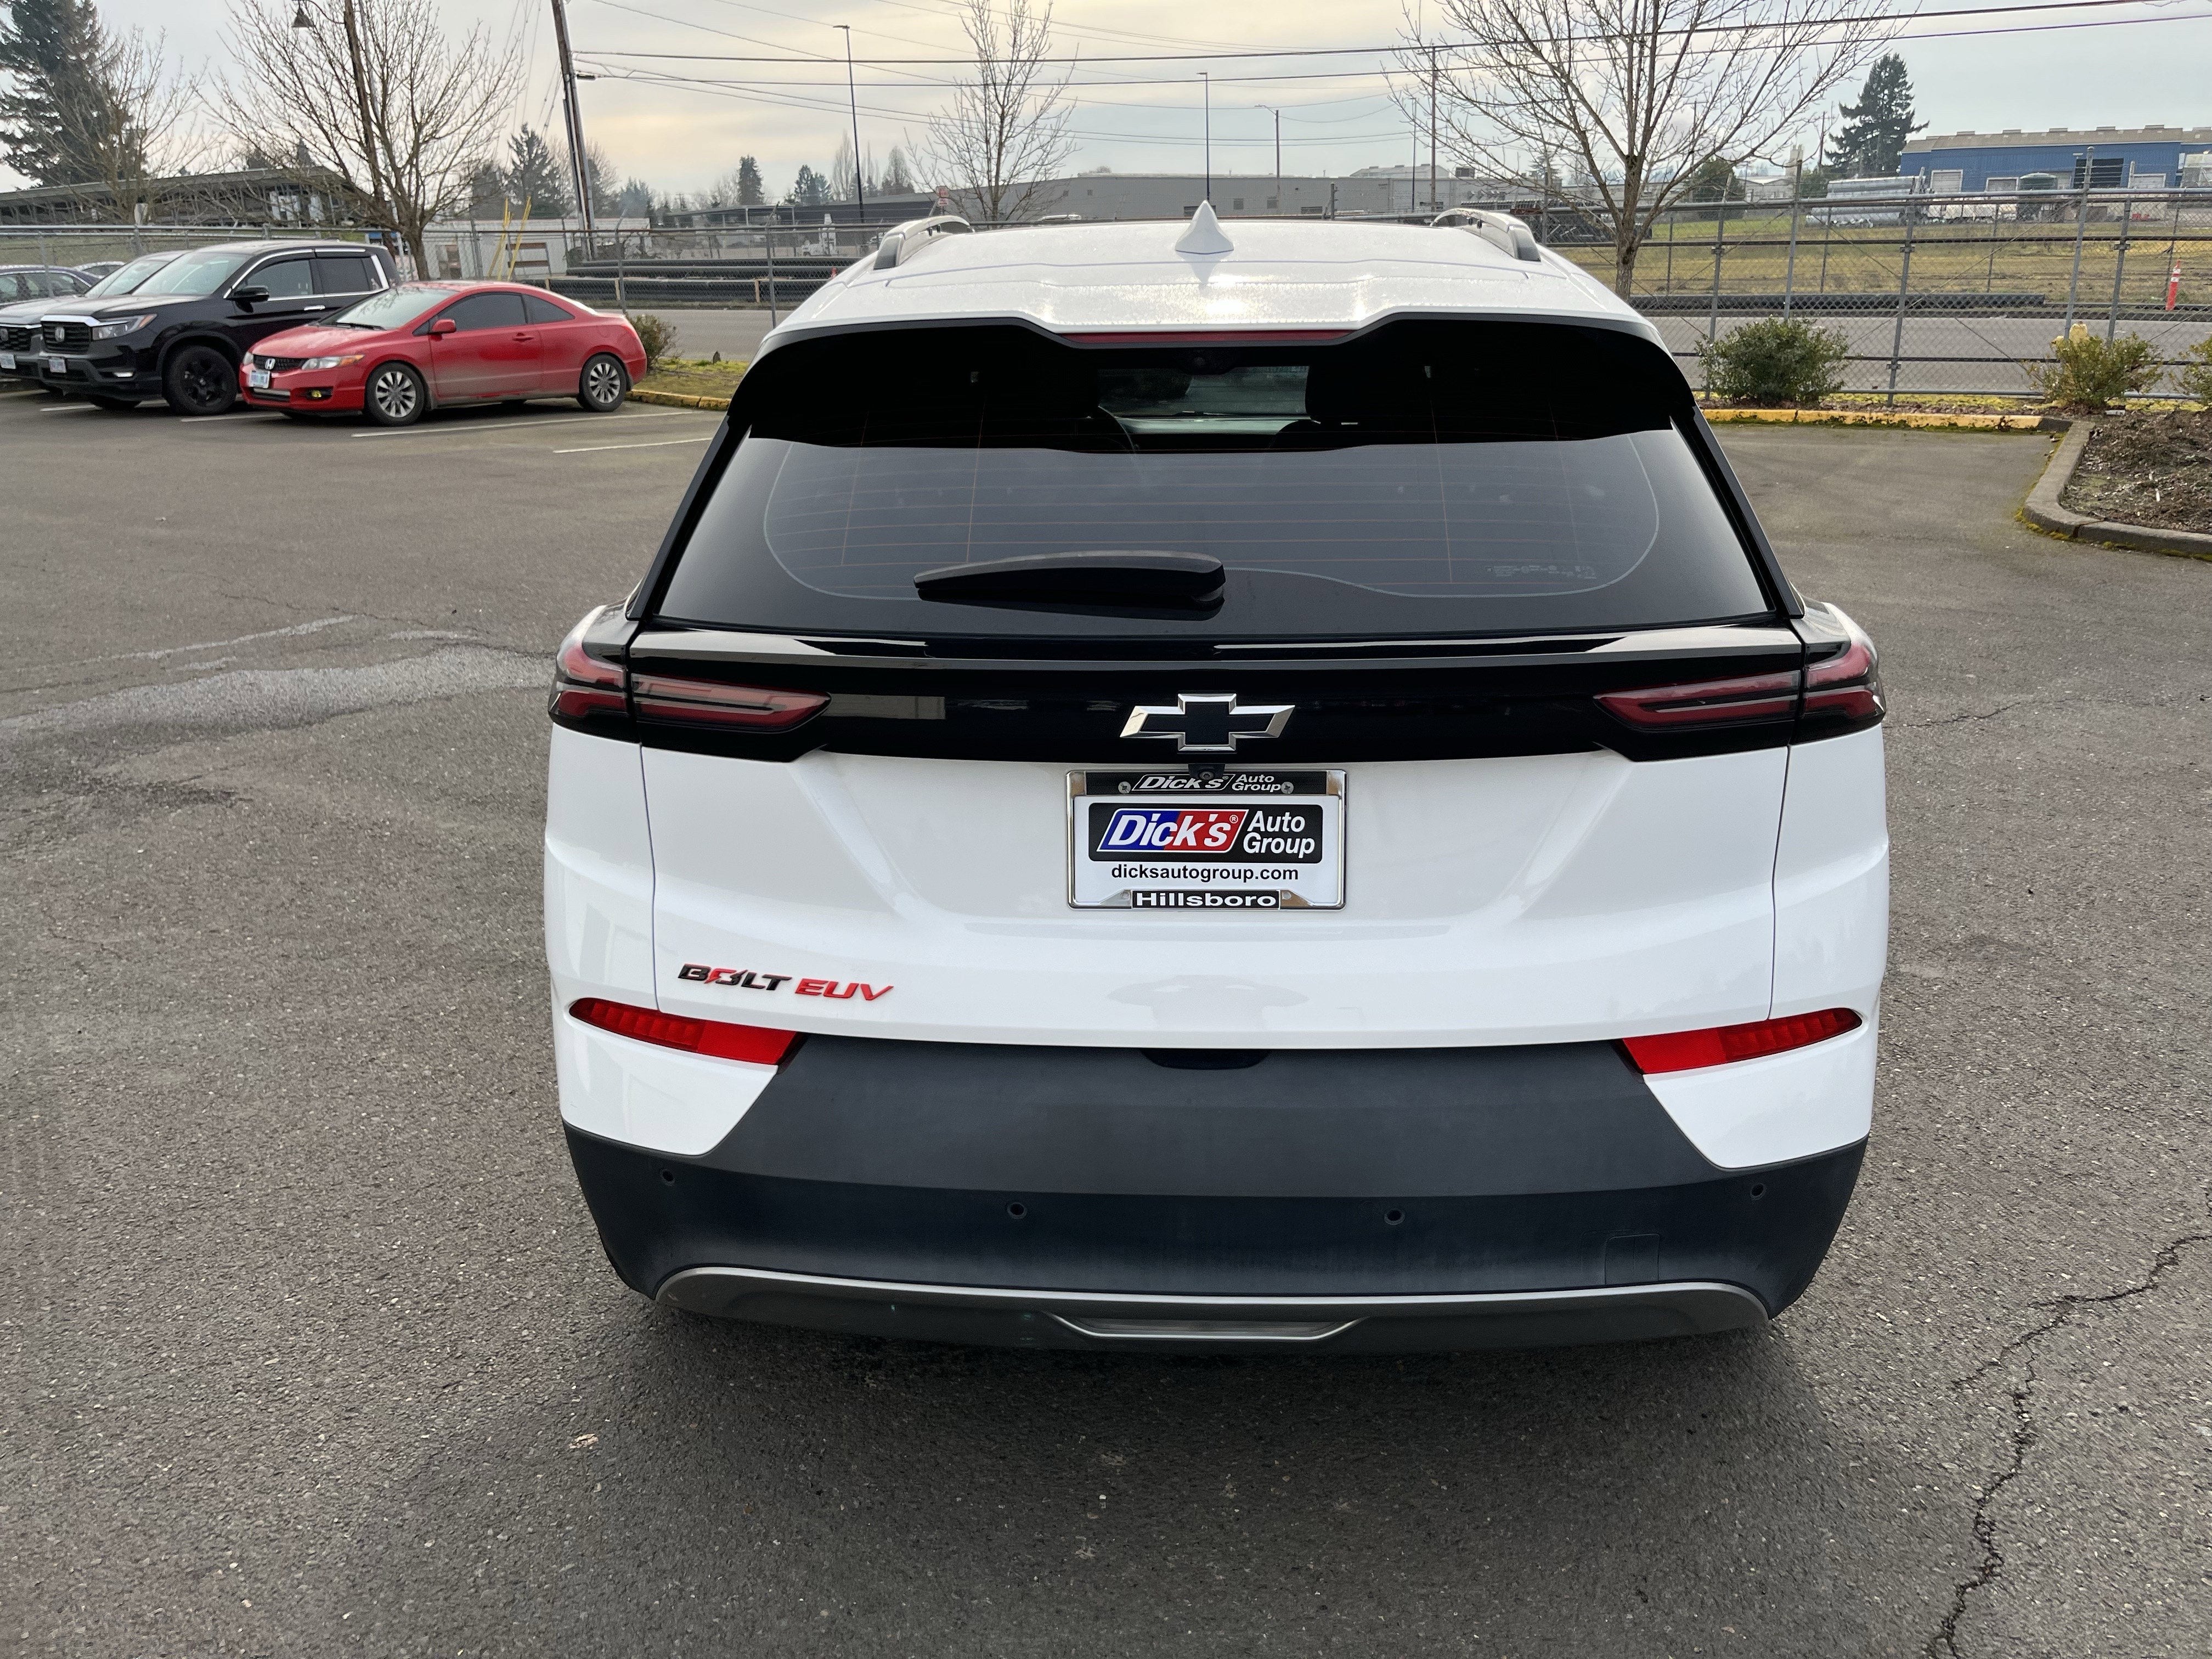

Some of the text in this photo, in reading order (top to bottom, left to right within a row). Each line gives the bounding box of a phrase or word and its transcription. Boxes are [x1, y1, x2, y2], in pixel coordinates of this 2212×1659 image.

[1139, 776, 1224, 789] Dicks
[1232, 782, 1281, 792] Group
[1235, 774, 1274, 782] Auto
[1108, 813, 1230, 847] Dick's
[1247, 810, 1306, 832] Auto
[1243, 832, 1315, 858] Group
[1111, 864, 1299, 883] dicksautogroup.com
[1136, 893, 1277, 907] Hillsboro
[678, 963, 894, 1001] BOLT EUV
